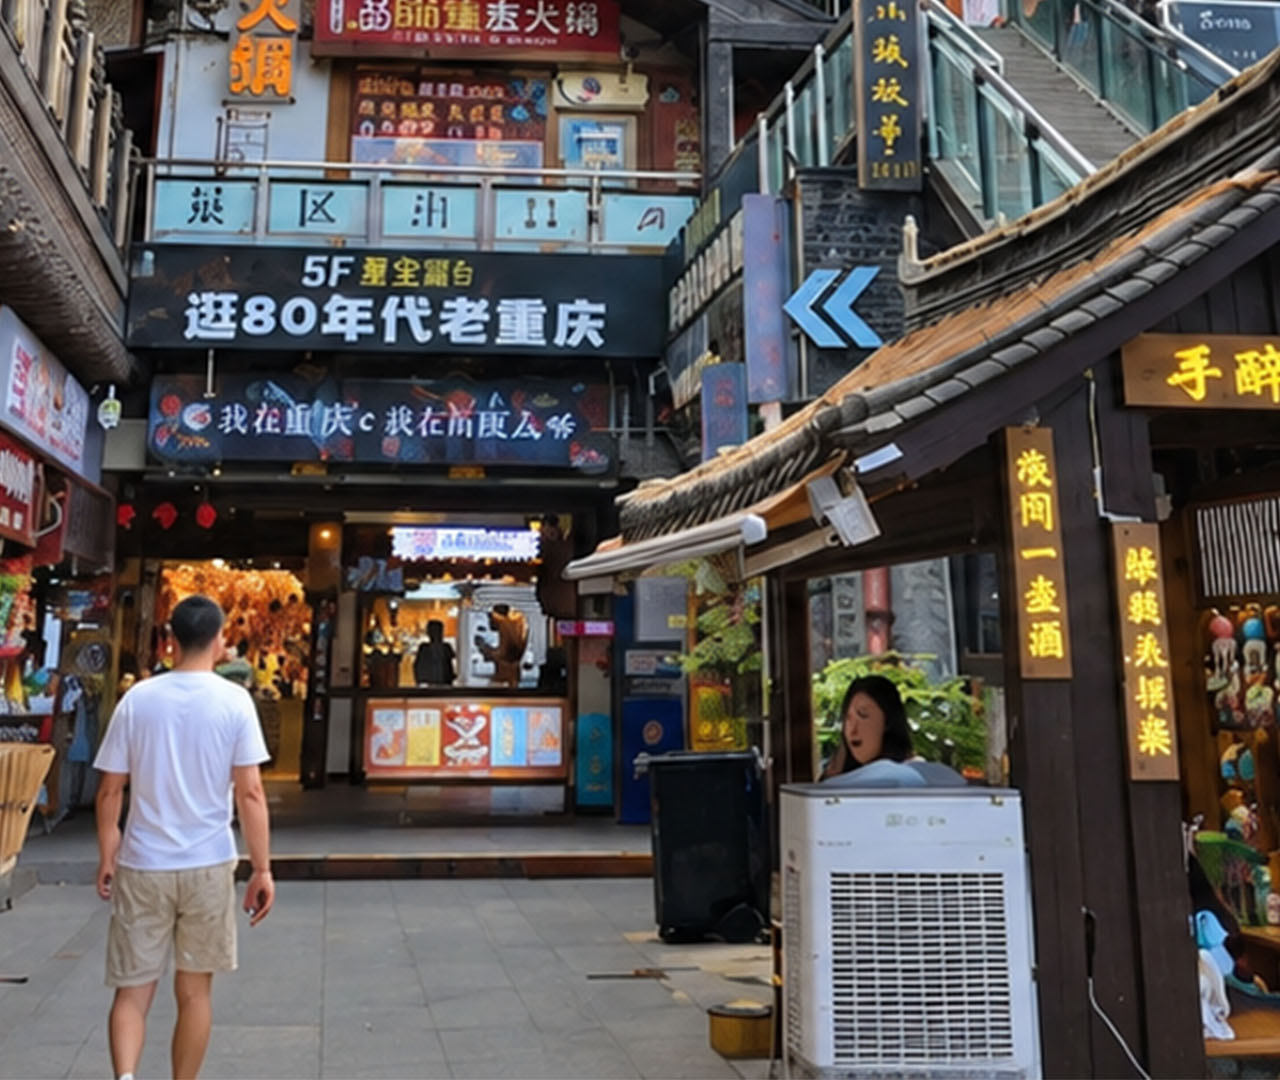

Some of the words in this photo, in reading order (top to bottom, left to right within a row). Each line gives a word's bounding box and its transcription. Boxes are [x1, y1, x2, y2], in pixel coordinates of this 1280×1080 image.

[301, 255, 355, 288] 5F
[184, 291, 607, 350] 逛80年代老重庆
